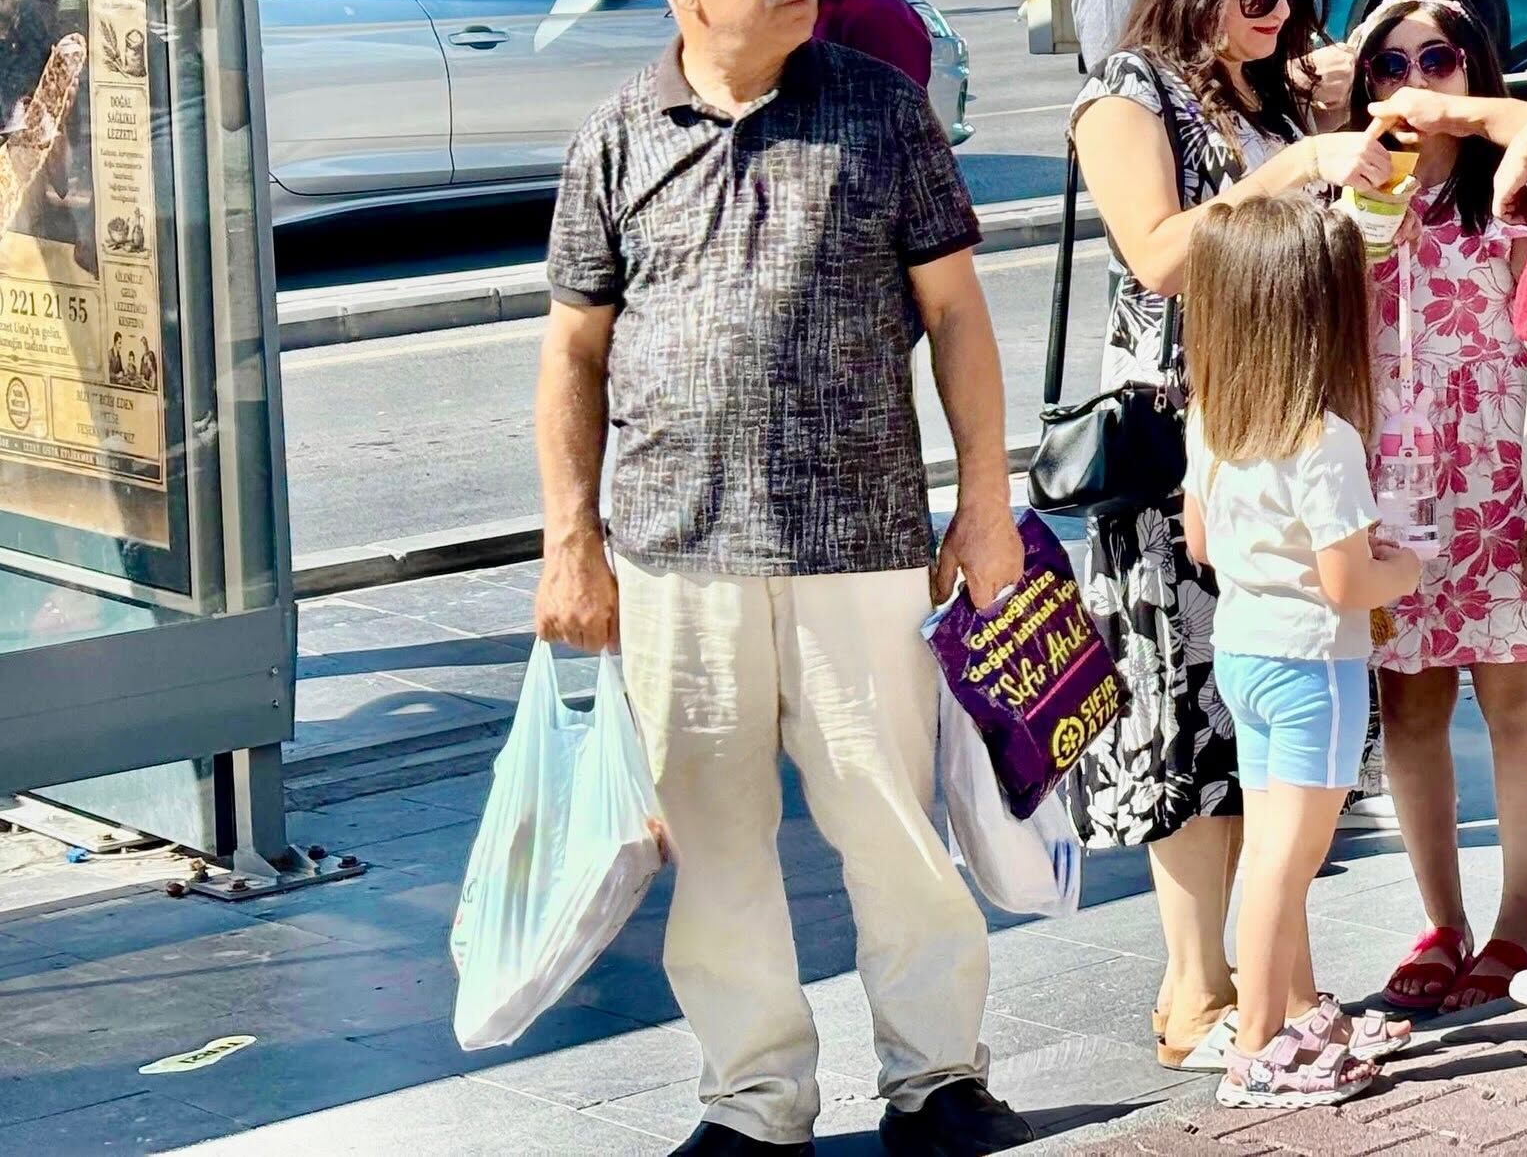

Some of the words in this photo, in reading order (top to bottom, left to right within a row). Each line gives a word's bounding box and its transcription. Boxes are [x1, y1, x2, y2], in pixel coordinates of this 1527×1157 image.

[10, 289, 37, 317] 221
[44, 292, 63, 320] 21
[68, 296, 88, 324] 55
[968, 640, 1015, 683] değer
[1080, 674, 1117, 722] SIFIR
[1087, 689, 1119, 740] ATIK
